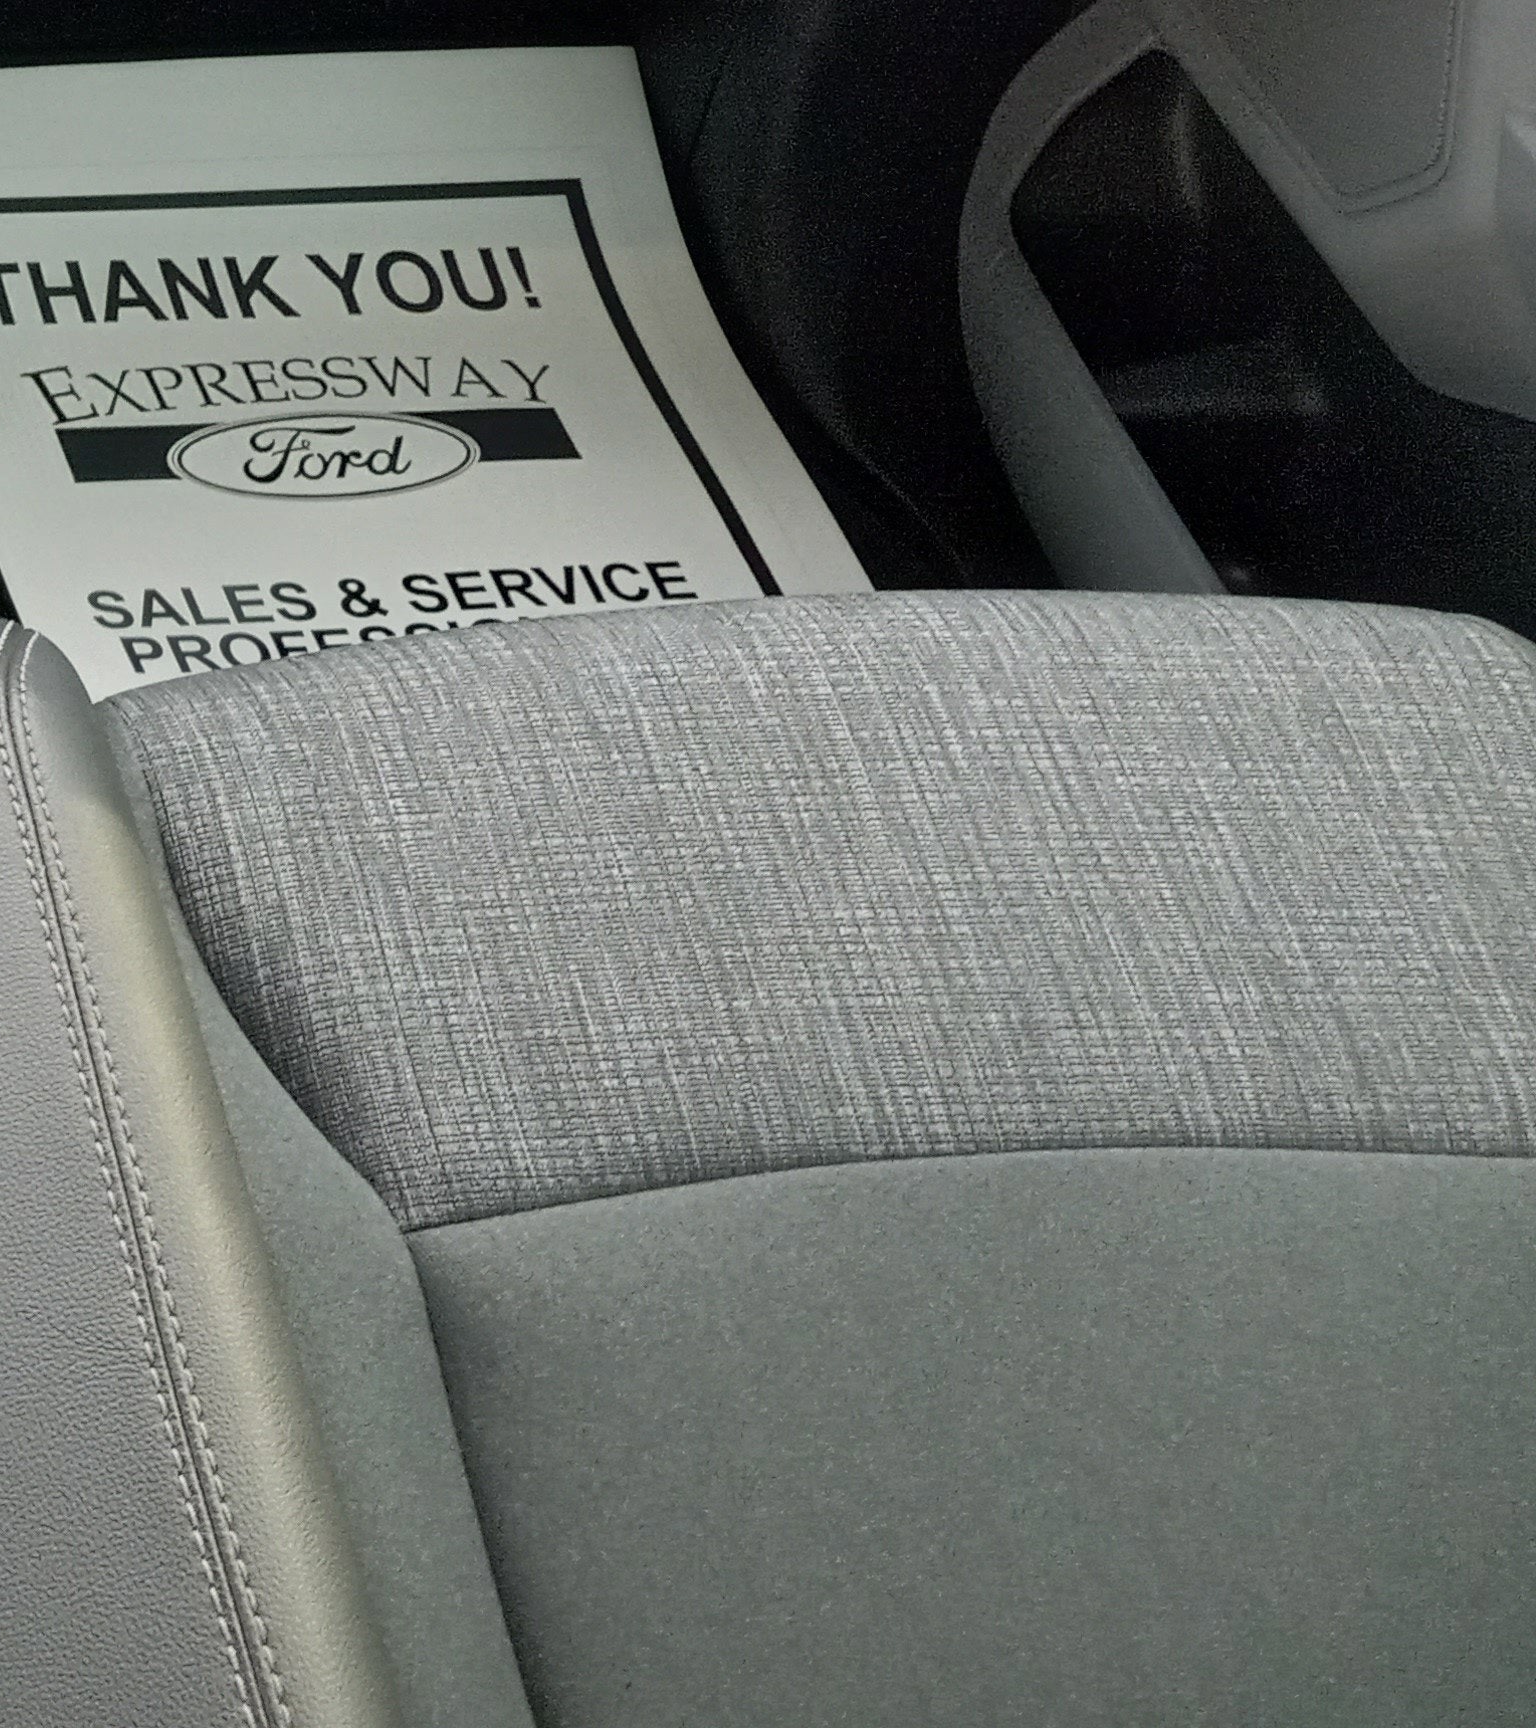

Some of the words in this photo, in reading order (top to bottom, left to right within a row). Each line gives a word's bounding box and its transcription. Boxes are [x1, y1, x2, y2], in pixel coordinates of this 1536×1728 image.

[306, 246, 544, 317] YOU!
[22, 356, 551, 428] EXPRESSWAY
[240, 426, 412, 483] Ford
[87, 580, 316, 631] SALES
[340, 576, 383, 617] &
[400, 559, 699, 612] SERVICE
